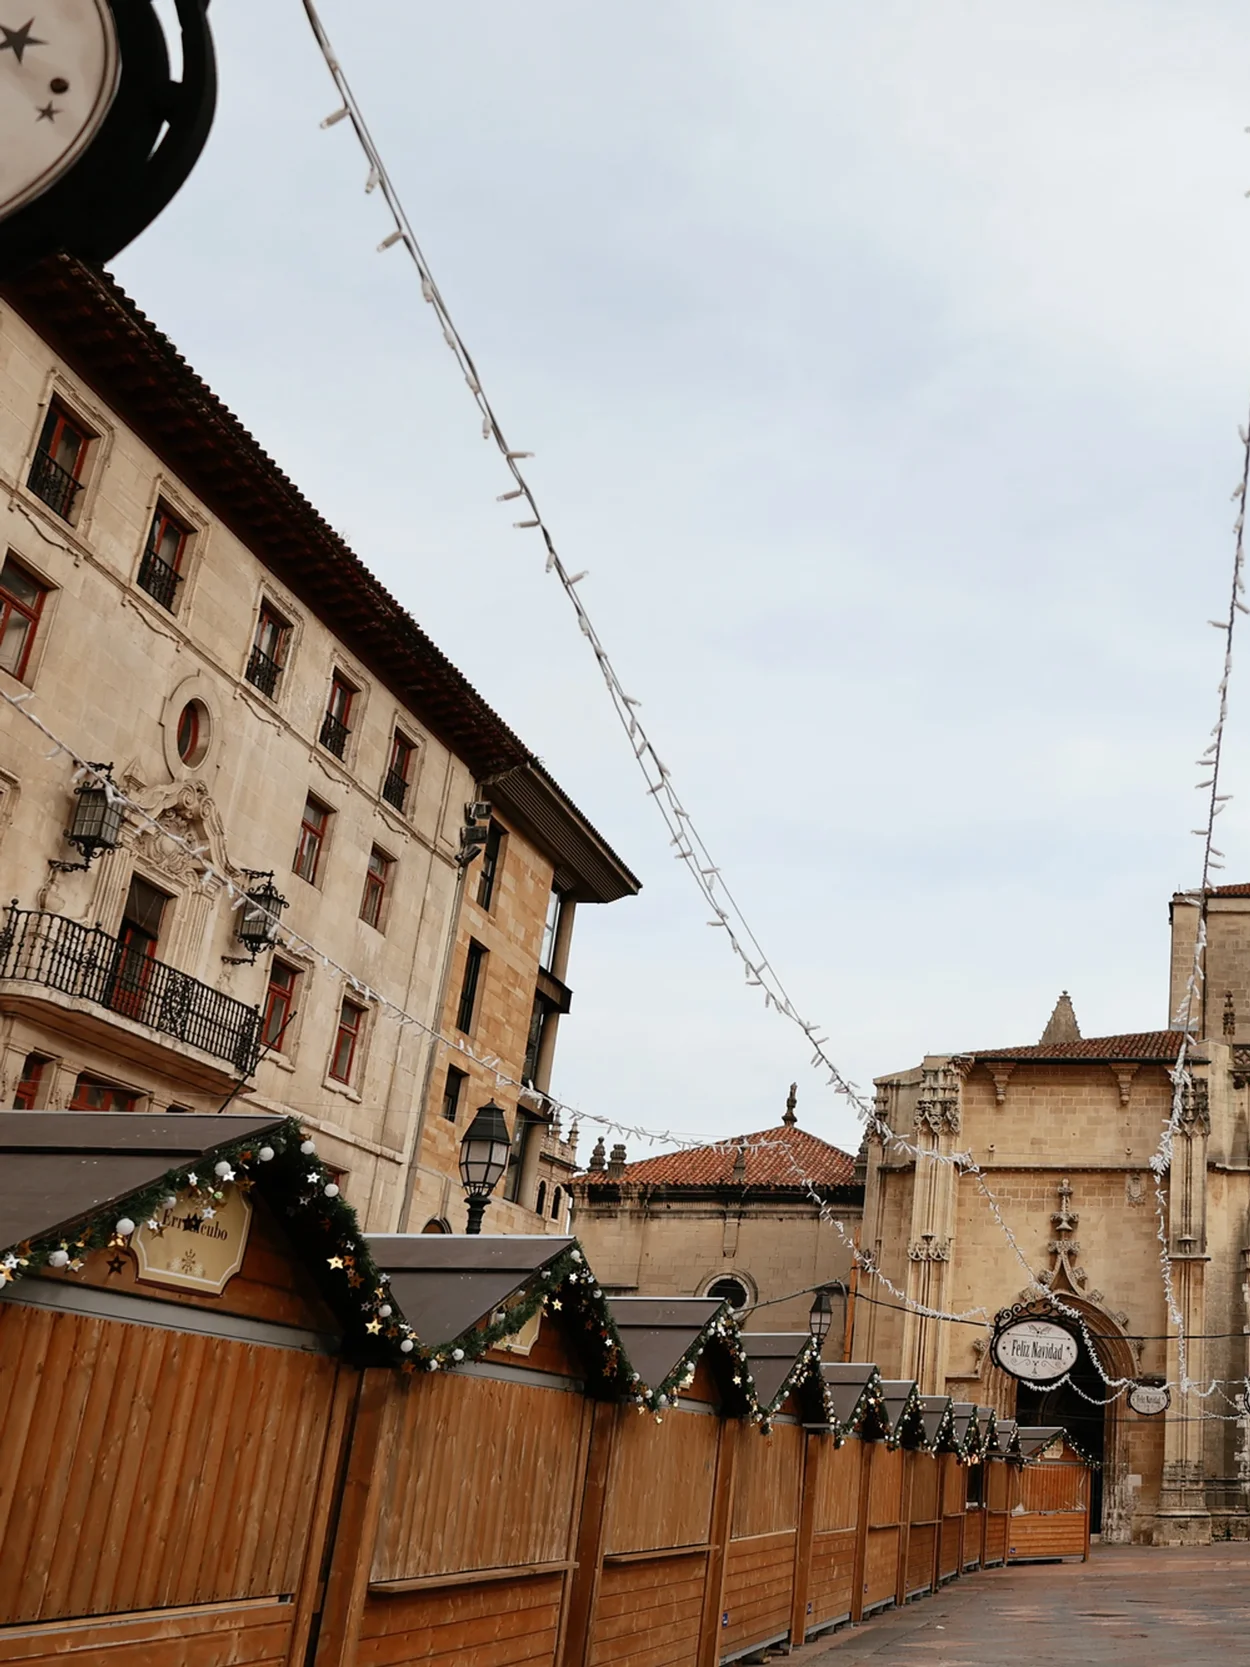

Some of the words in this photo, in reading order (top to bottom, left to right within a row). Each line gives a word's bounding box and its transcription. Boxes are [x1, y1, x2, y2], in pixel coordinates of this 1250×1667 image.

[200, 1221, 228, 1241] cubo
[1011, 1339, 1030, 1357] Feliz
[1031, 1341, 1064, 1360] Navidad
